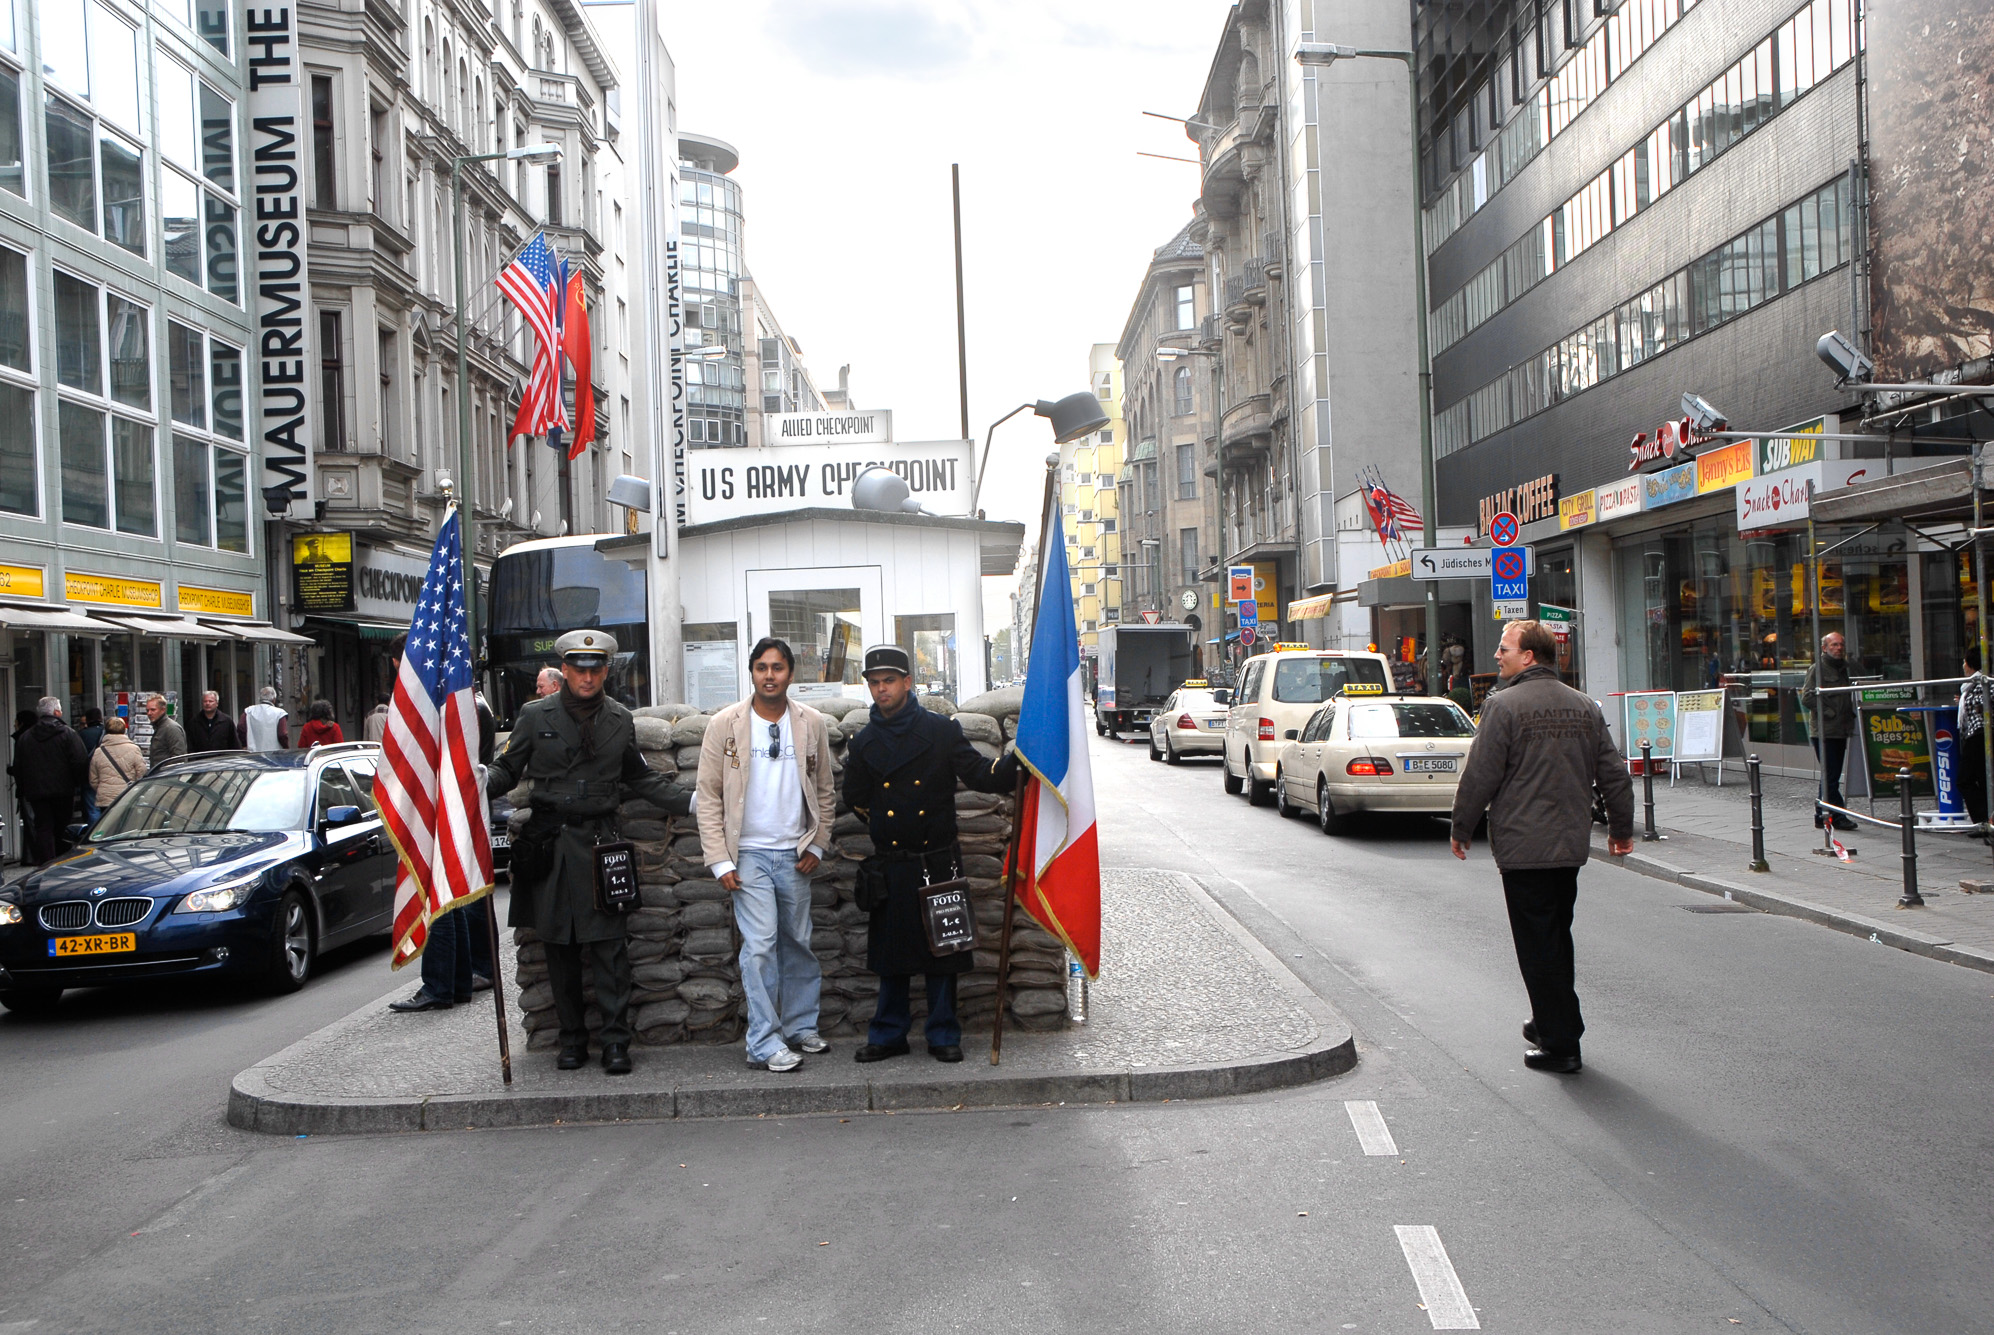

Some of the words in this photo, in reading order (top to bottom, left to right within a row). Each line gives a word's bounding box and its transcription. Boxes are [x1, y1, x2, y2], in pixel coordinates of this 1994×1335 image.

[247, 8, 292, 92] THE
[253, 116, 308, 500] MAUERMUSEUM
[781, 417, 813, 437] ALLIED
[816, 415, 875, 436] CHECKPOINT
[1628, 429, 1663, 471] Snack
[1762, 421, 1823, 474] SUBWAY
[1700, 455, 1734, 487] Janny's
[1735, 447, 1751, 473] Eis
[701, 467, 735, 500] US
[747, 464, 811, 499] ARMY
[822, 457, 959, 496] CHPOINT
[1517, 474, 1554, 525] COFFEE
[1562, 498, 1574, 517] CITY
[1576, 493, 1593, 513] GRILL
[1599, 490, 1615, 513] PIZZA
[1622, 484, 1640, 506] PASTA
[1742, 485, 1771, 520] Snack
[1440, 557, 1477, 569] Jüdisches
[66, 579, 99, 597] CHECKPOINT
[99, 583, 121, 599] CHARLIE
[1495, 583, 1524, 596] TAXI
[179, 592, 204, 607] CHECKPOINT
[203, 595, 221, 609] CHARLIE
[1503, 604, 1524, 615] Taxen
[1240, 618, 1257, 627] TAXI
[534, 639, 558, 652] SUP
[1870, 715, 1903, 732] Sub
[1902, 724, 1915, 732] des
[1871, 732, 1902, 744] Tages
[1412, 760, 1419, 769] B
[1424, 760, 1429, 769] E
[1431, 760, 1453, 770] 5080
[1938, 751, 1952, 805] PEPSI
[604, 854, 627, 865] FOTO
[933, 894, 960, 906] FOTO
[58, 936, 130, 953] 42-XR-BR
